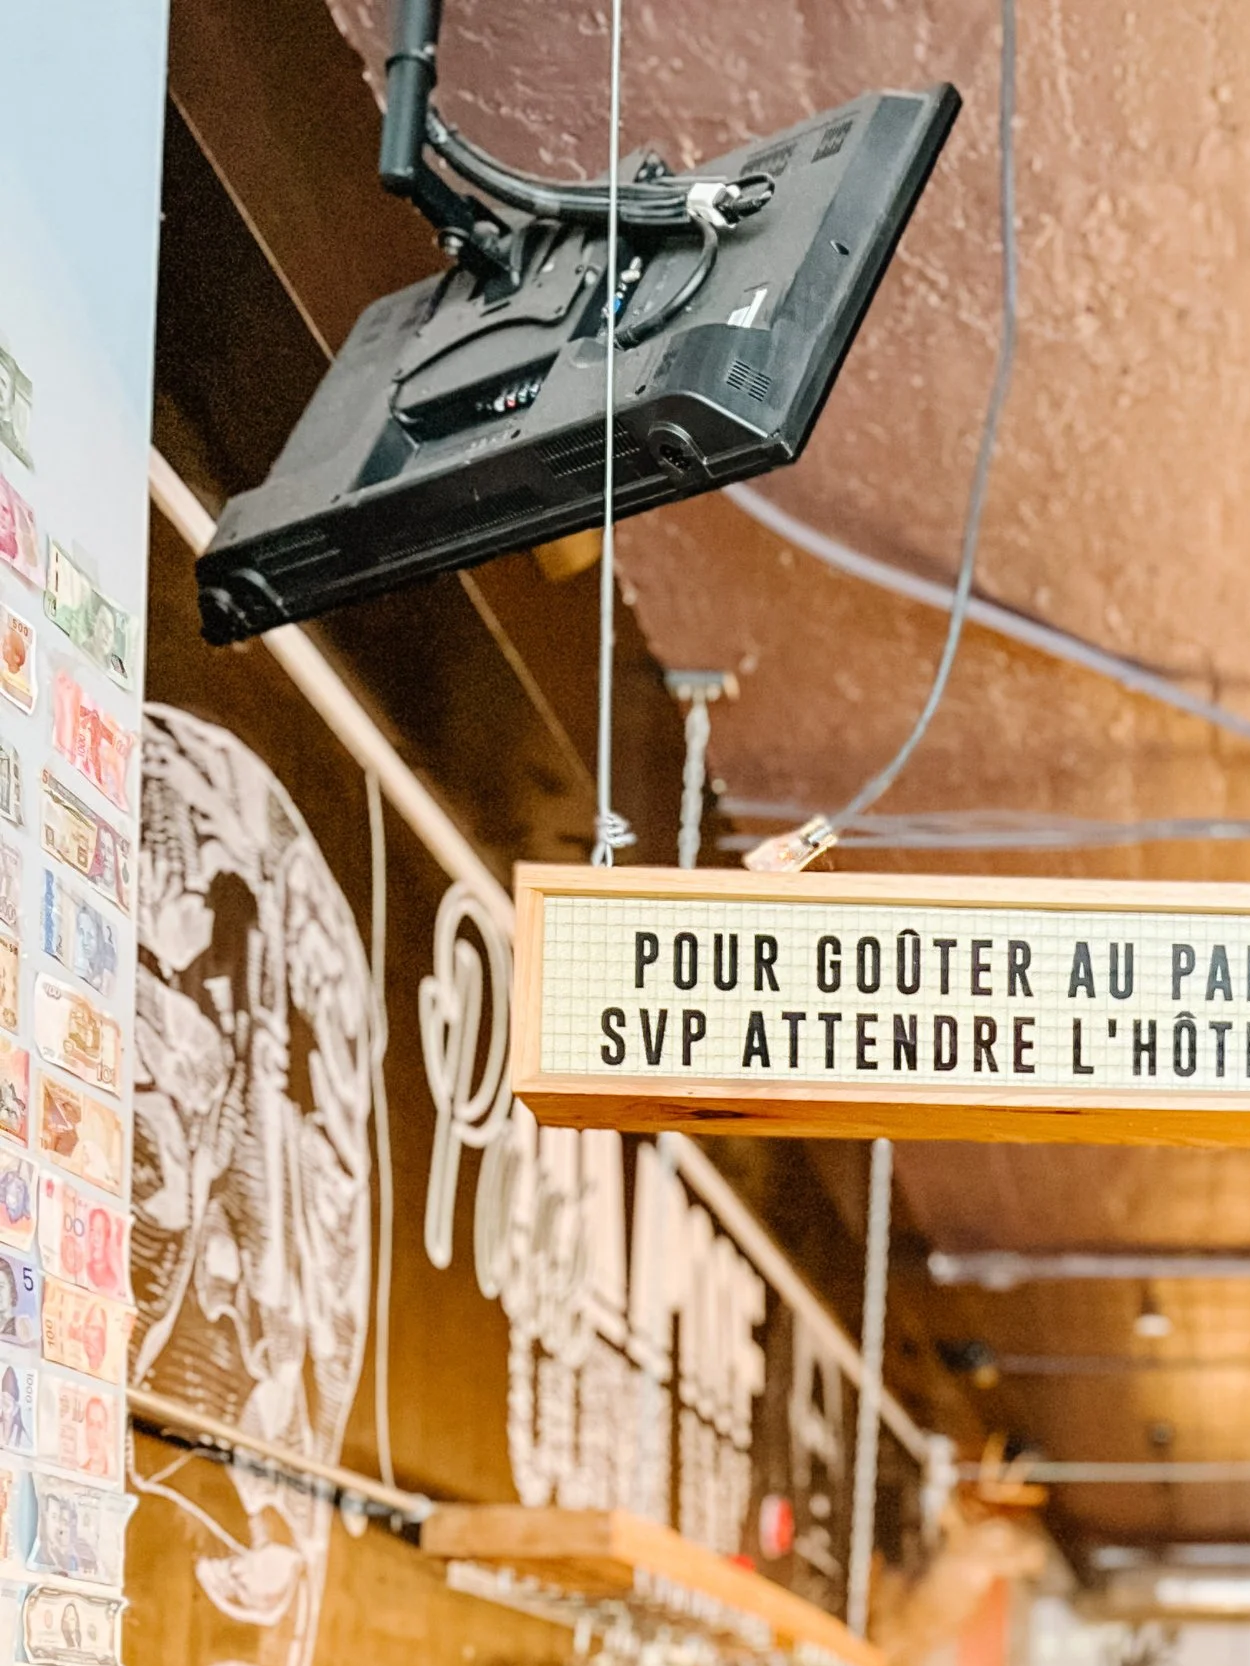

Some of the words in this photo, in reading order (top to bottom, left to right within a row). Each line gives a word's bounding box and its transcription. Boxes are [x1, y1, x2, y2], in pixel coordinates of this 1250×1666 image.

[12, 618, 29, 637] 500
[634, 931, 780, 994] POUR
[816, 928, 1034, 999] GOÛTER
[1067, 941, 1135, 1001] AU
[601, 1007, 707, 1068] SVP
[741, 1011, 1036, 1075] ATTENDRE
[22, 1266, 34, 1292] 5
[45, 1318, 56, 1348] 100
